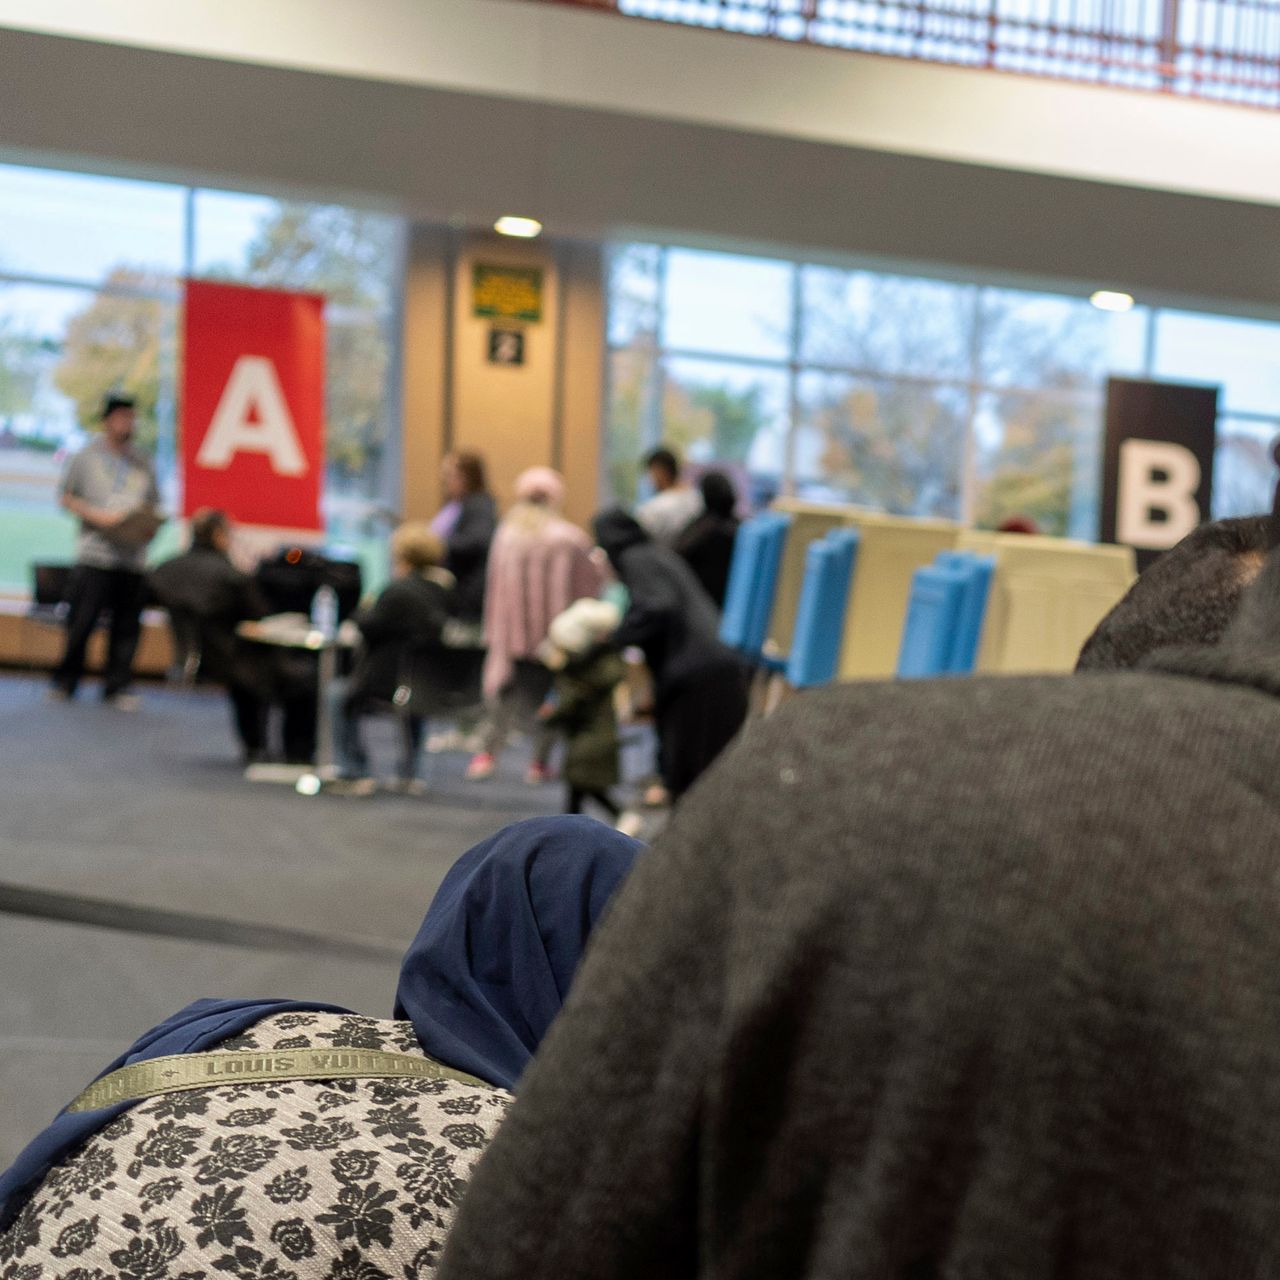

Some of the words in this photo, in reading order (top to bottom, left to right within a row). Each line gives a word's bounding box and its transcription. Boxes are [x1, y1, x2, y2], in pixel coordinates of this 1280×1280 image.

[195, 354, 310, 479] A
[1116, 437, 1202, 550] B
[207, 1057, 295, 1076] LOUIS
